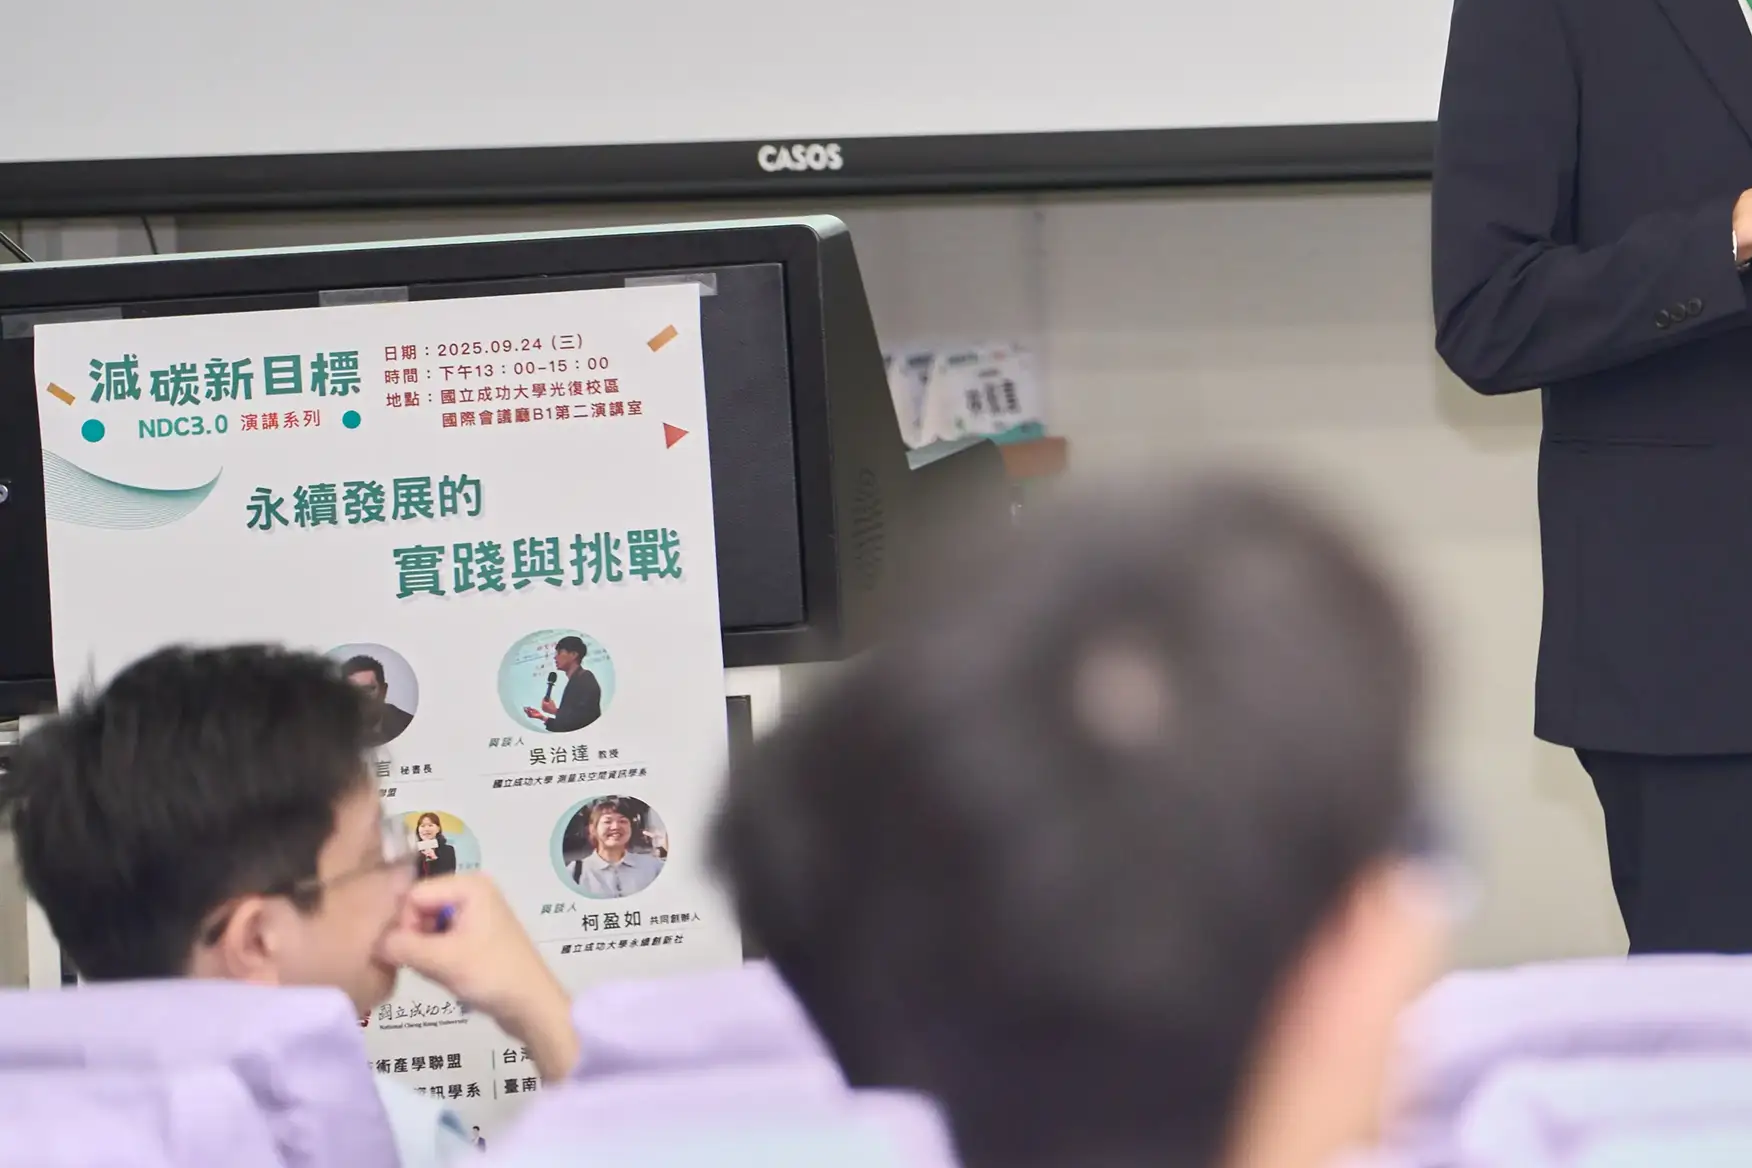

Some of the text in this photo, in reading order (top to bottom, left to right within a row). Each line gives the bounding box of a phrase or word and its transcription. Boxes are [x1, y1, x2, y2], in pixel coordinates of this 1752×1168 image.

[757, 142, 845, 173] CASOS
[89, 350, 362, 407] 減碳新目標
[138, 409, 321, 440] NDC3.0 演講系列
[245, 473, 484, 532] 永續發展的
[392, 527, 684, 600] 實踐與挑戰
[529, 743, 590, 766] 吳治達
[492, 775, 554, 790] 國立成功大學
[581, 910, 643, 932] 柯盈如
[367, 1053, 463, 1074] 術產學聯盟
